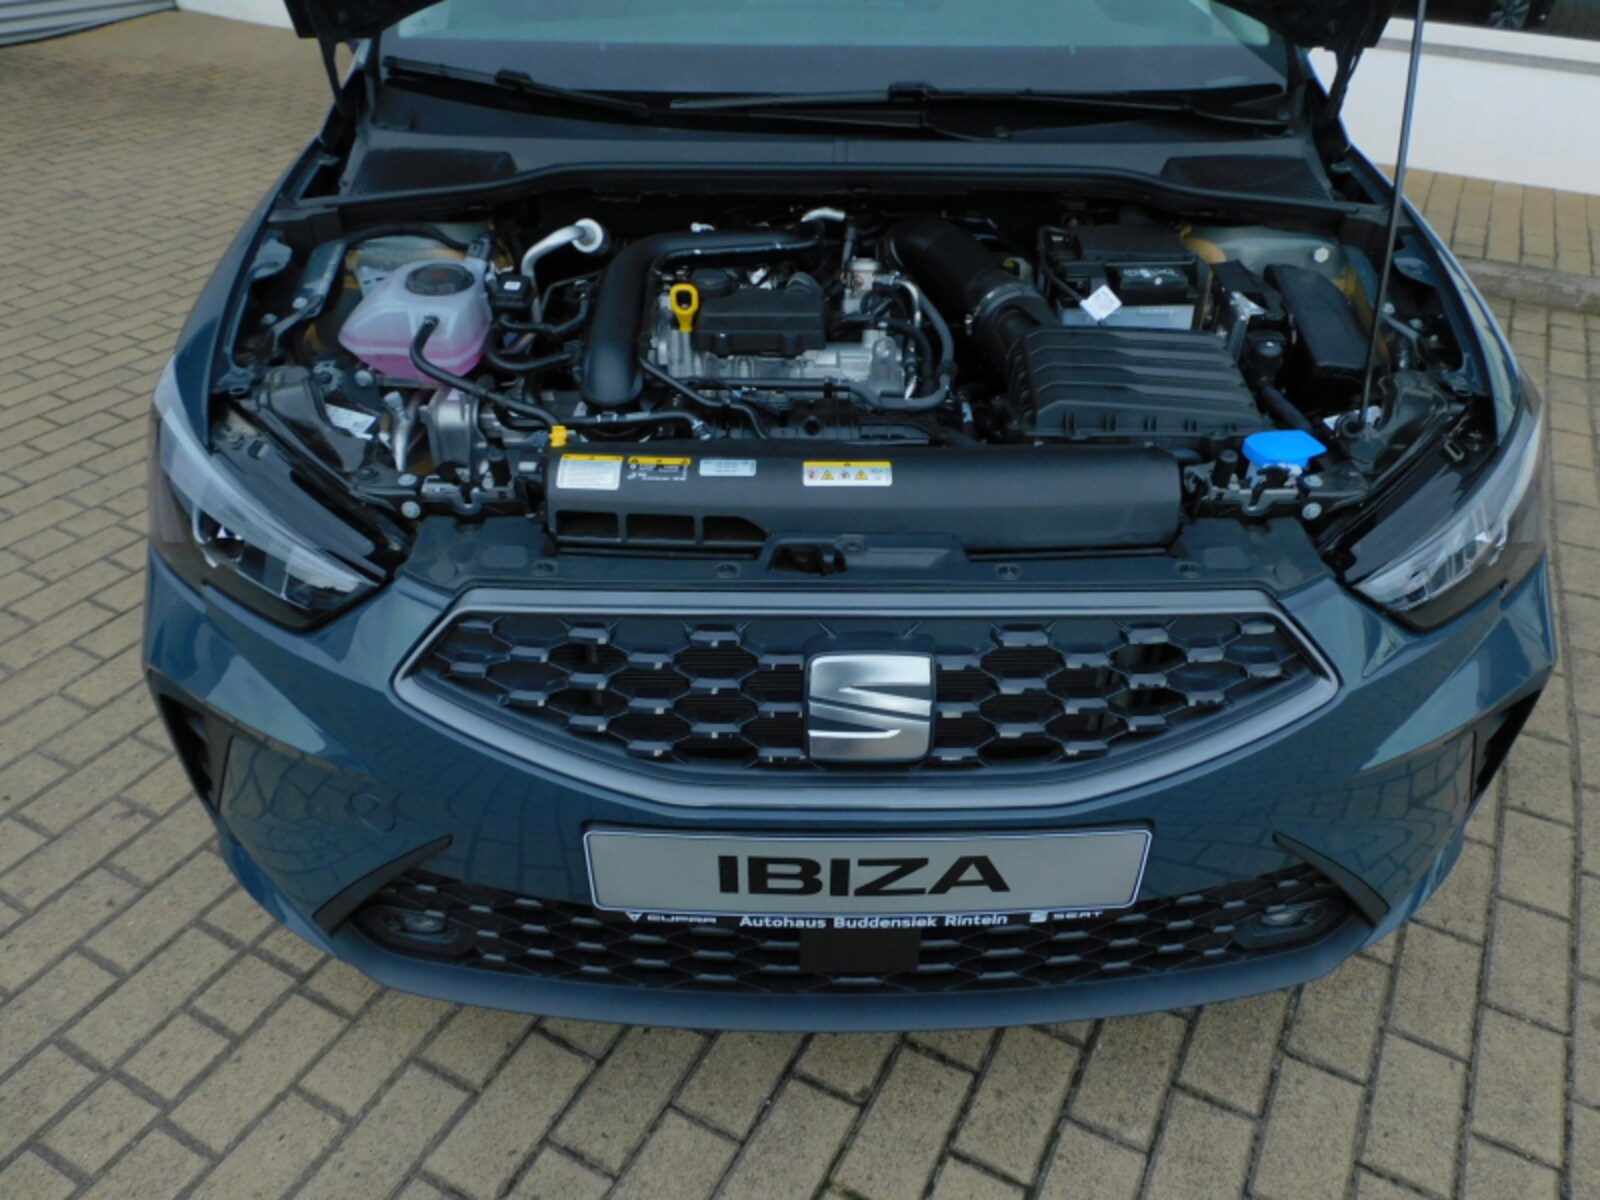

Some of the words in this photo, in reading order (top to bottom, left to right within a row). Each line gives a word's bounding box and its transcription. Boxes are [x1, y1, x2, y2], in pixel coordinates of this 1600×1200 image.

[718, 855, 1011, 897] IBIZA
[739, 914, 827, 929] Autohaus
[833, 915, 938, 929] Buddensiek
[945, 913, 1009, 927] Rinteln
